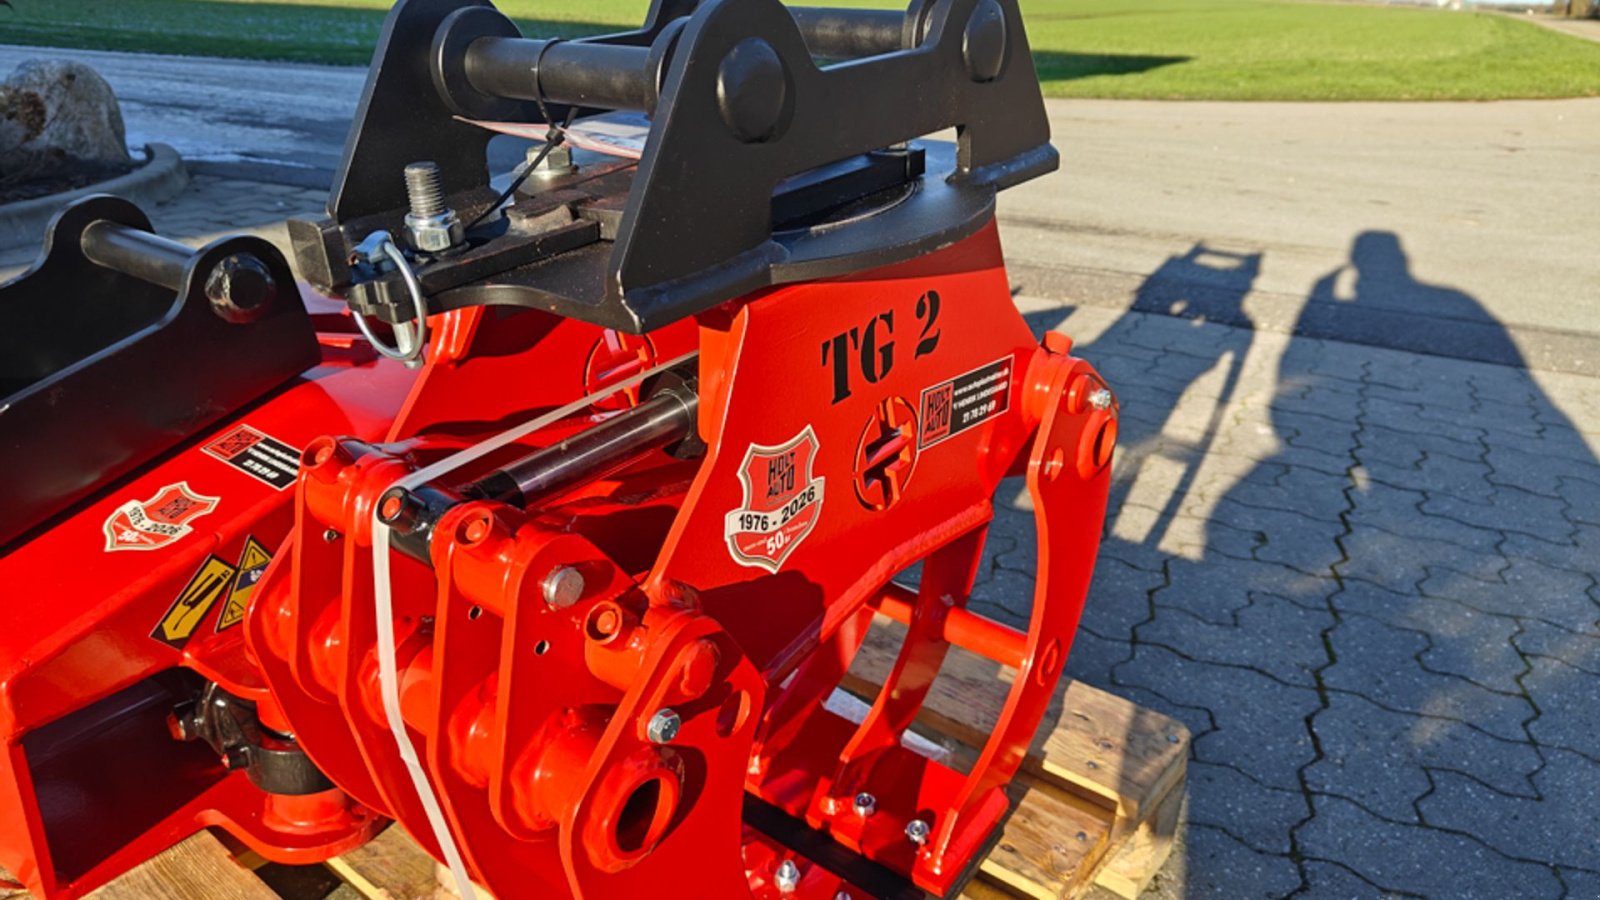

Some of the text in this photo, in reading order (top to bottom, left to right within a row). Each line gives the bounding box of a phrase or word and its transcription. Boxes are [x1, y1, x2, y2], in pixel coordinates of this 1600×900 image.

[822, 290, 941, 405] TG 2
[926, 401, 949, 432] AUTO
[928, 386, 951, 418] HOLT
[767, 464, 795, 499] AUTO
[768, 452, 795, 486] HOLT
[739, 514, 769, 531] 1976
[781, 486, 816, 525] 2026
[766, 531, 785, 555] 50
